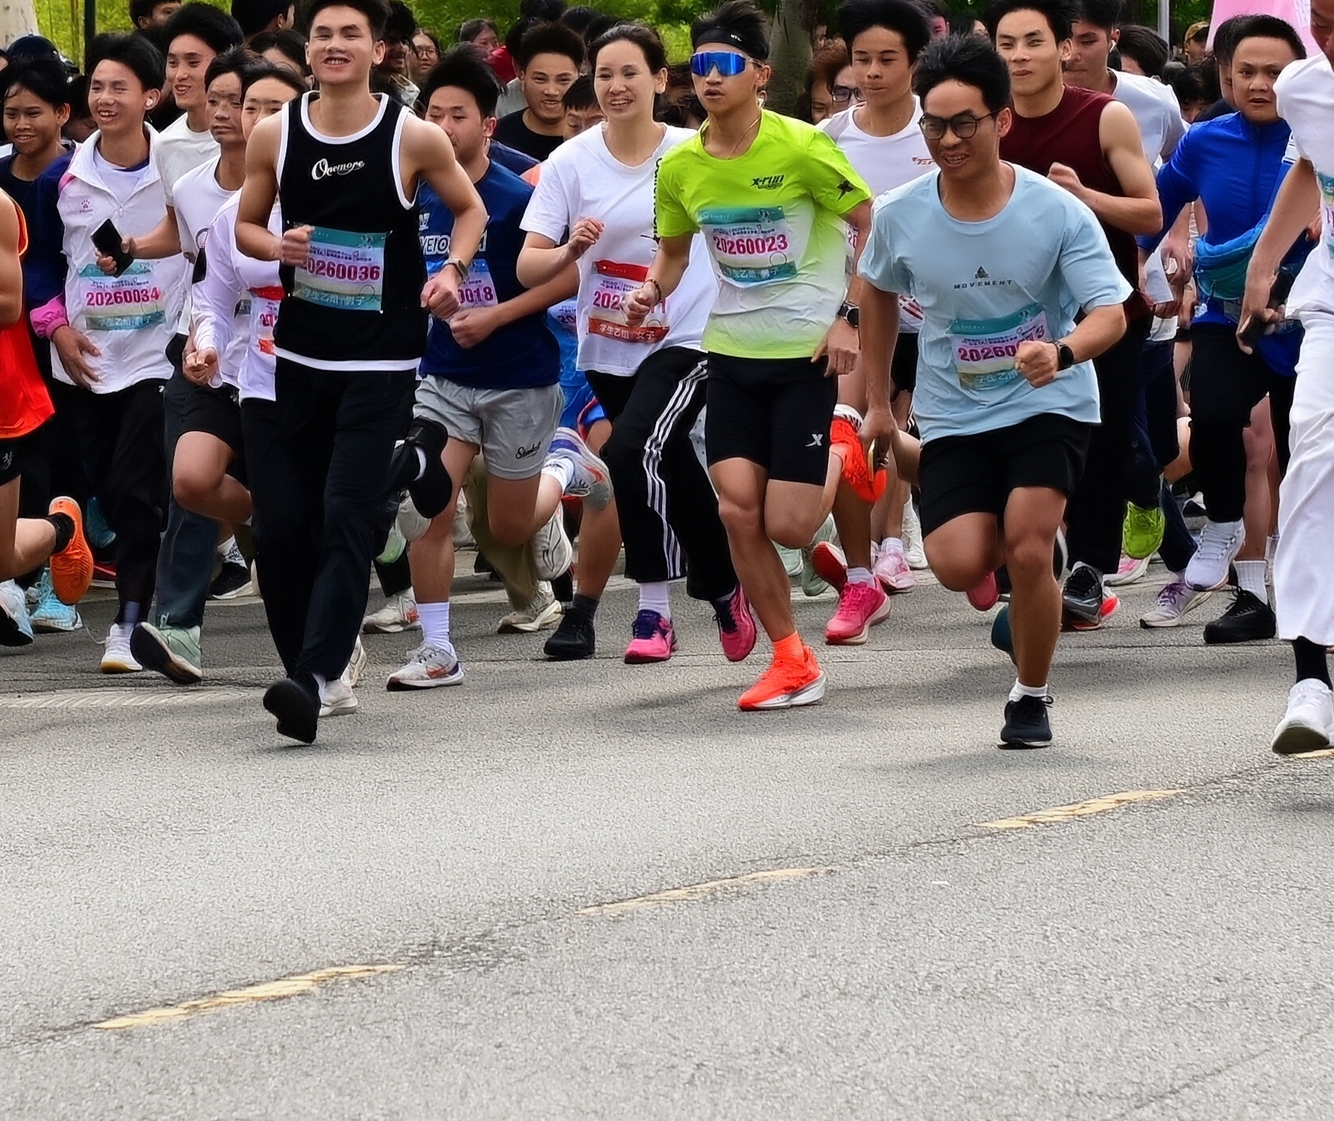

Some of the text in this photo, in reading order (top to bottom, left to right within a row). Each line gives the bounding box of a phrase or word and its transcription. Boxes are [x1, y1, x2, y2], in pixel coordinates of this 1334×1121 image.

[713, 234, 789, 255] 20260023
[297, 257, 380, 281] 0260036
[953, 279, 1013, 290] MOVEMENT
[85, 286, 161, 307] 20260034
[599, 323, 655, 341] 学生乙组 女子
